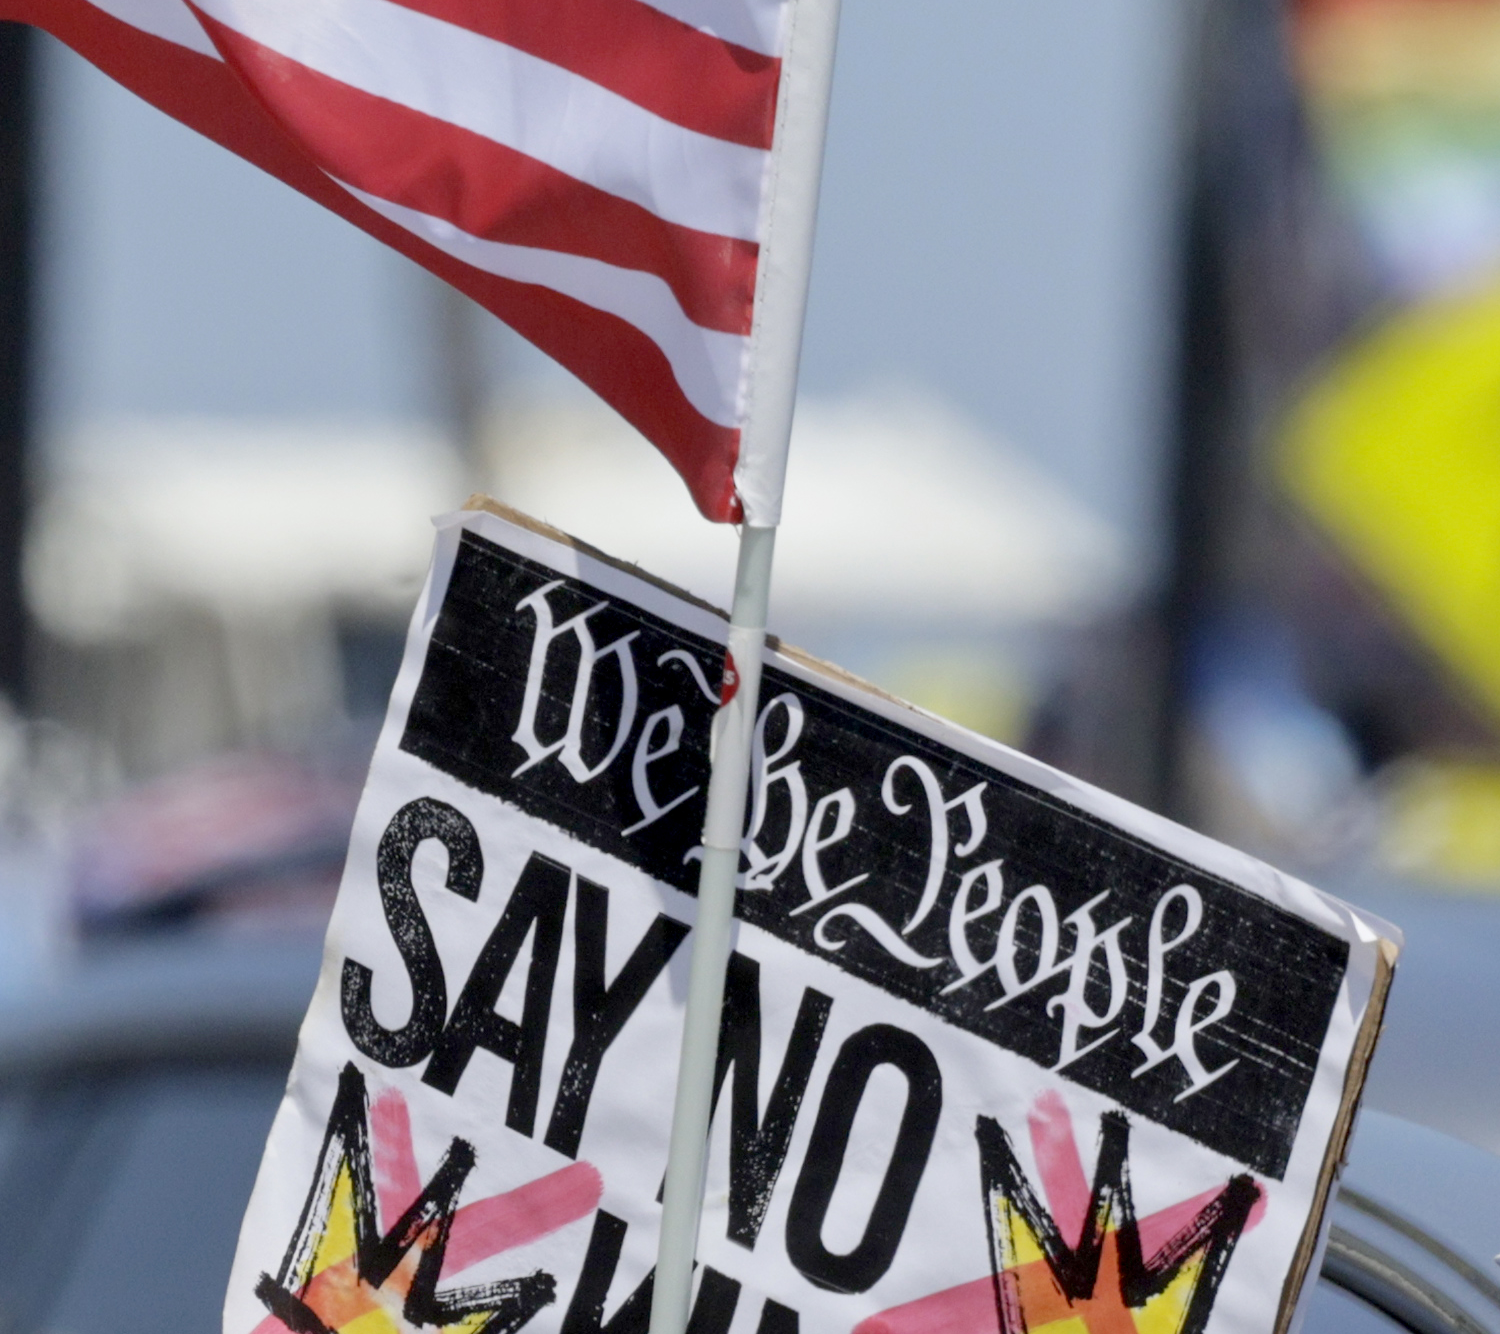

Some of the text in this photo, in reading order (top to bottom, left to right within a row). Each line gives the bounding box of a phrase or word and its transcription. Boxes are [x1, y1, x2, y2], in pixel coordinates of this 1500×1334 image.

[340, 795, 943, 1295] SAY NO
[510, 579, 700, 837] We
[813, 754, 1241, 1105] People
